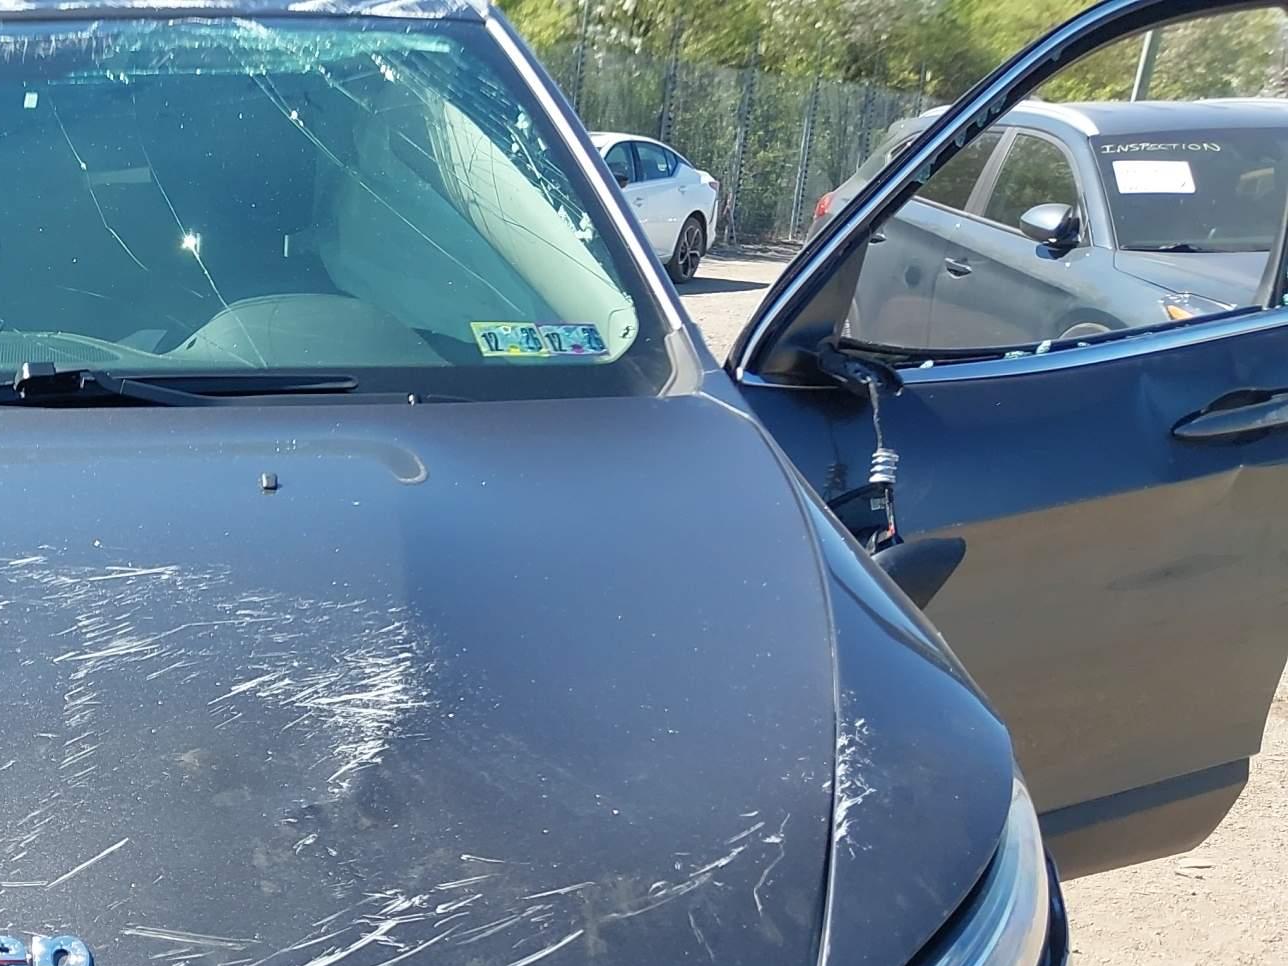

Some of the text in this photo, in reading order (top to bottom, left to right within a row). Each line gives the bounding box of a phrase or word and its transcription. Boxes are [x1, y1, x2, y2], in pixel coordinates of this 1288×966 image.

[1101, 142, 1221, 154] INSPECTION
[481, 331, 504, 352] 12
[545, 332, 567, 352] 12
